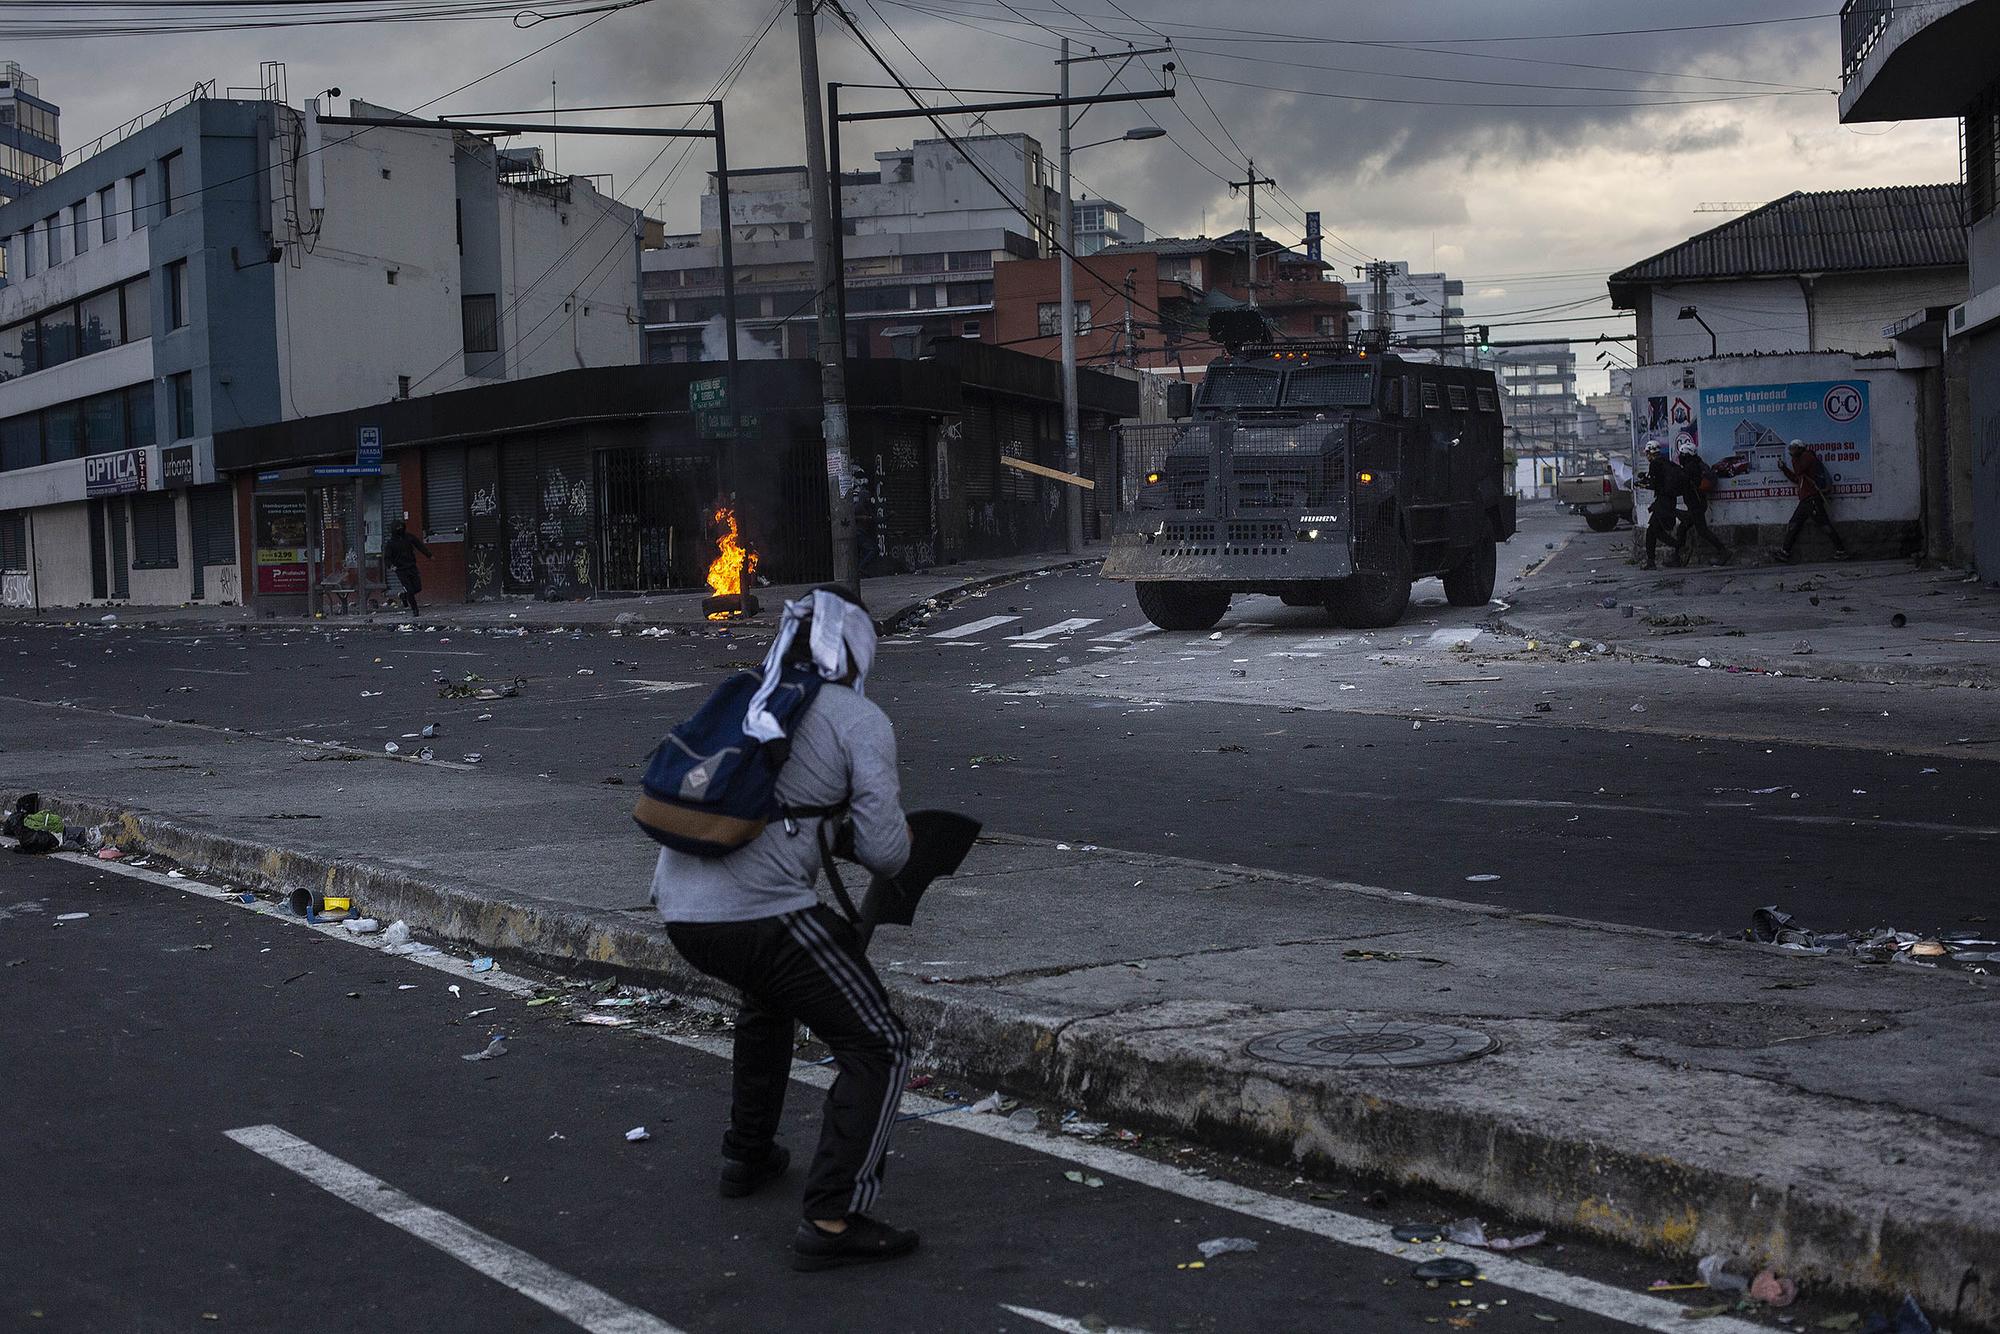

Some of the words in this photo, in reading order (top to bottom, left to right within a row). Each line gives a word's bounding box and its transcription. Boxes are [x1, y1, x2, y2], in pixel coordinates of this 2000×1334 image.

[1706, 394, 1715, 404] La
[1716, 394, 1742, 405] Mayor
[1745, 389, 1787, 401] Variedad
[1706, 406, 1717, 416] de
[1718, 405, 1745, 415] Casas
[1746, 403, 1756, 413] al
[1757, 402, 1785, 413] mejor
[1787, 400, 1818, 412] precio
[359, 448, 381, 456] PARADA
[1806, 441, 1842, 454] roponga
[1844, 441, 1855, 450] su
[1824, 451, 1836, 462] de
[1837, 451, 1860, 463] pago
[87, 452, 138, 482] OPTICA
[138, 450, 147, 491] OPTICA
[1741, 489, 1768, 499] ventas:
